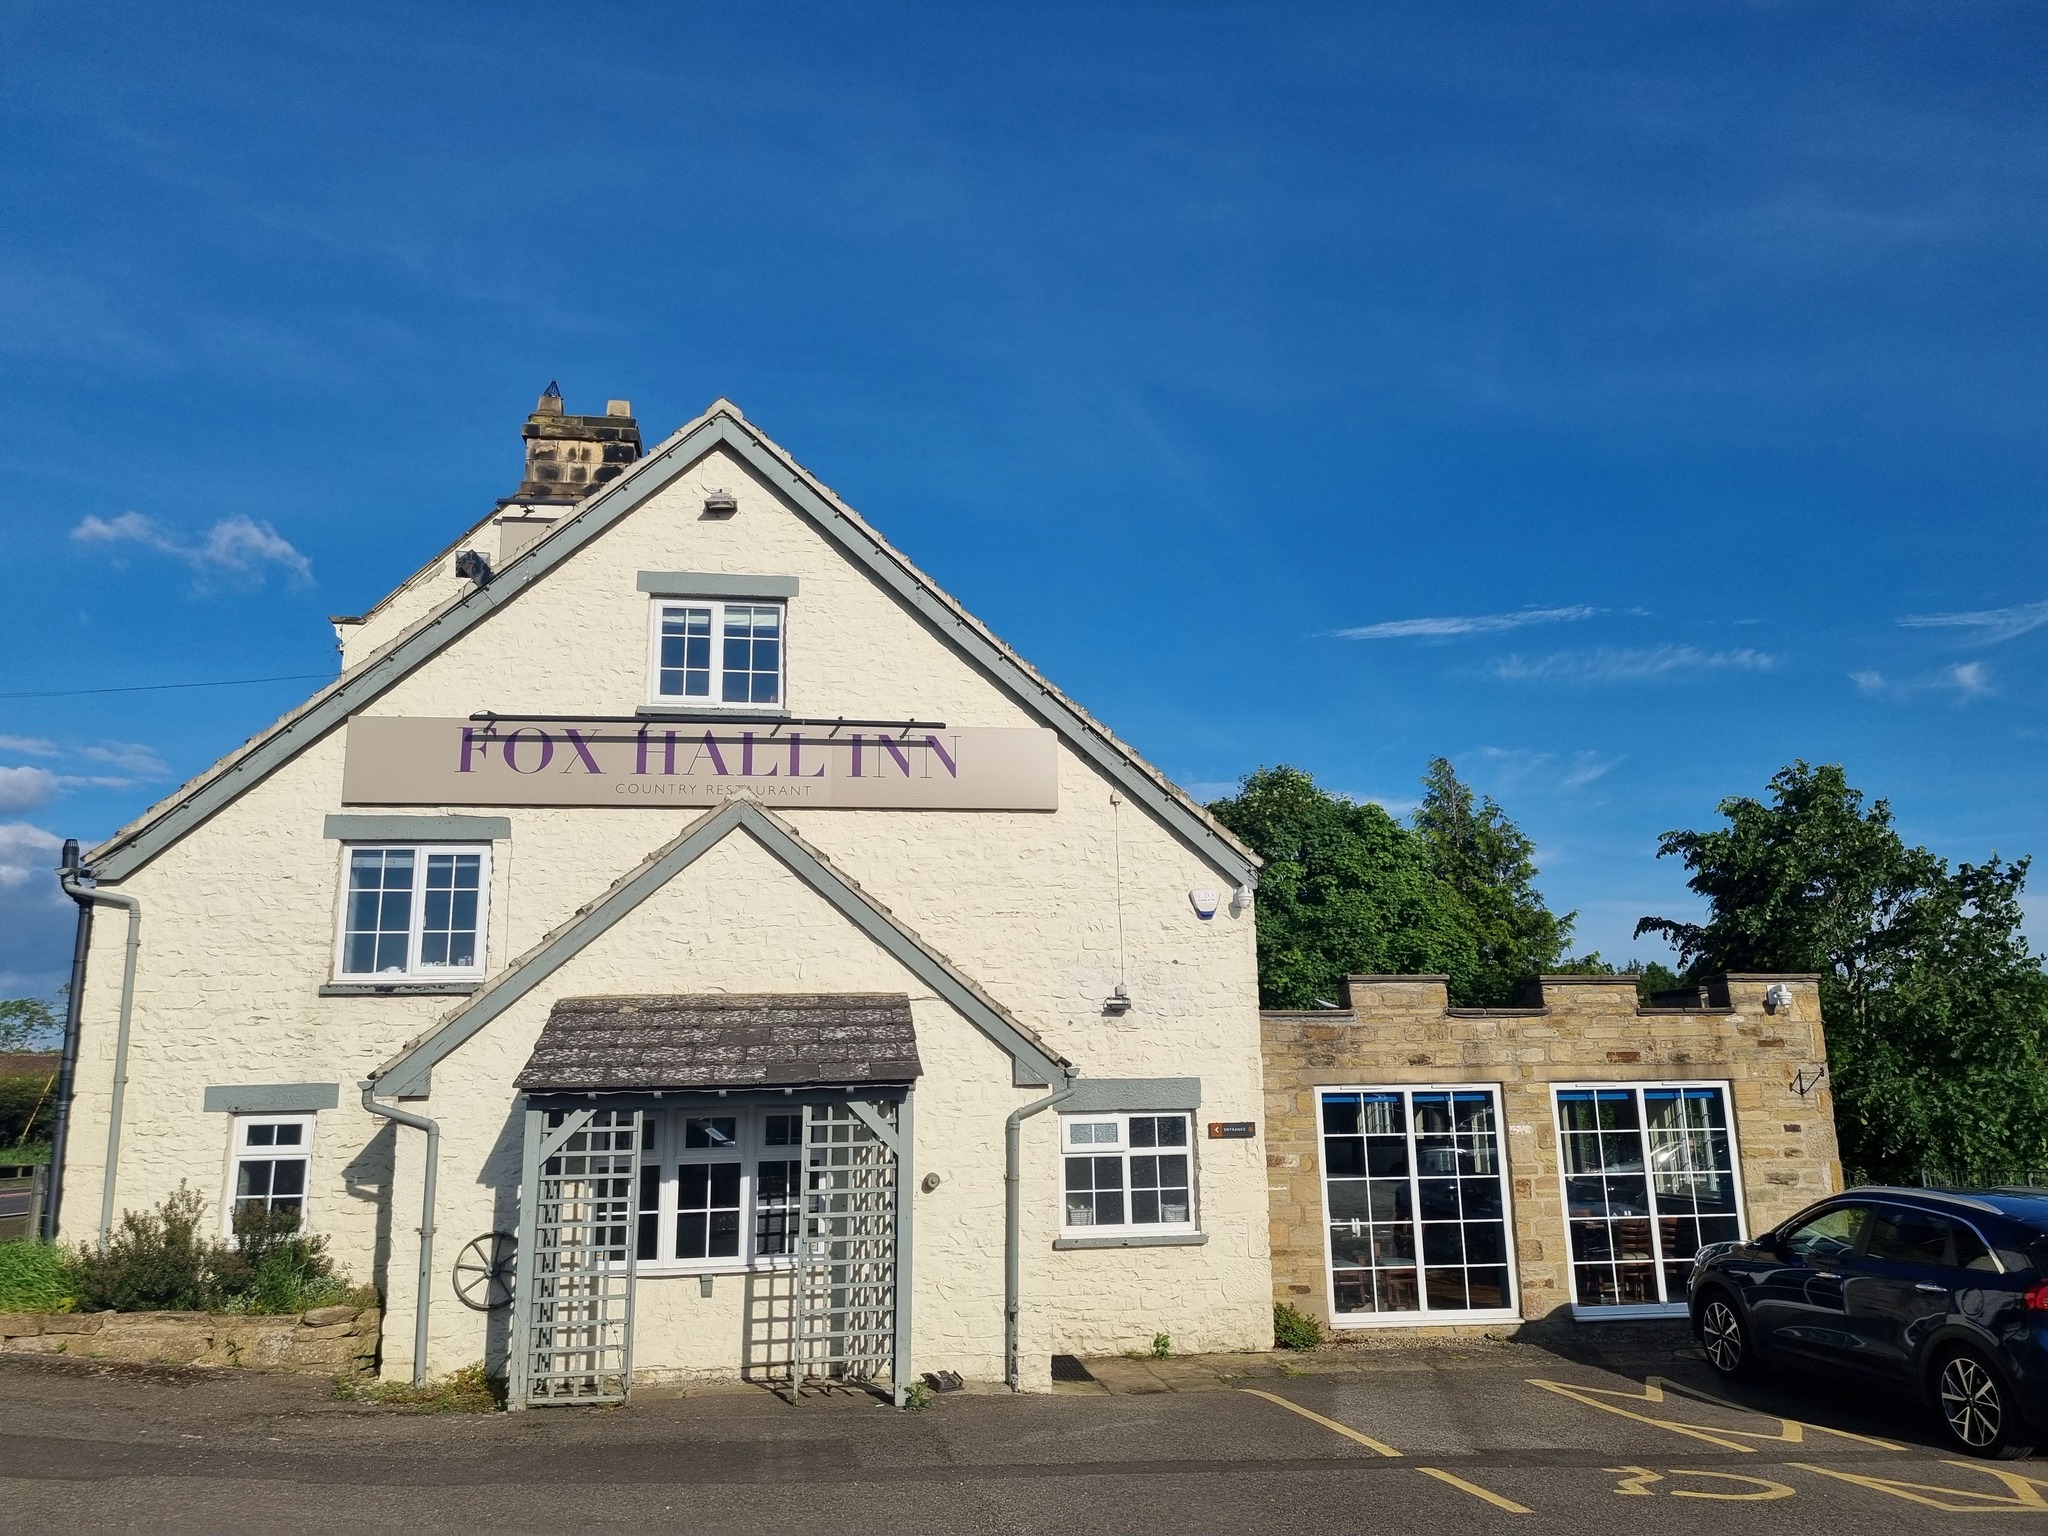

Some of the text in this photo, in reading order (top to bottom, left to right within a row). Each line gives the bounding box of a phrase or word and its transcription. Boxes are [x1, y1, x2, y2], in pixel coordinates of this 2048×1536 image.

[454, 726, 962, 779] FOX HALL INN
[615, 783, 697, 795] COUNTRY
